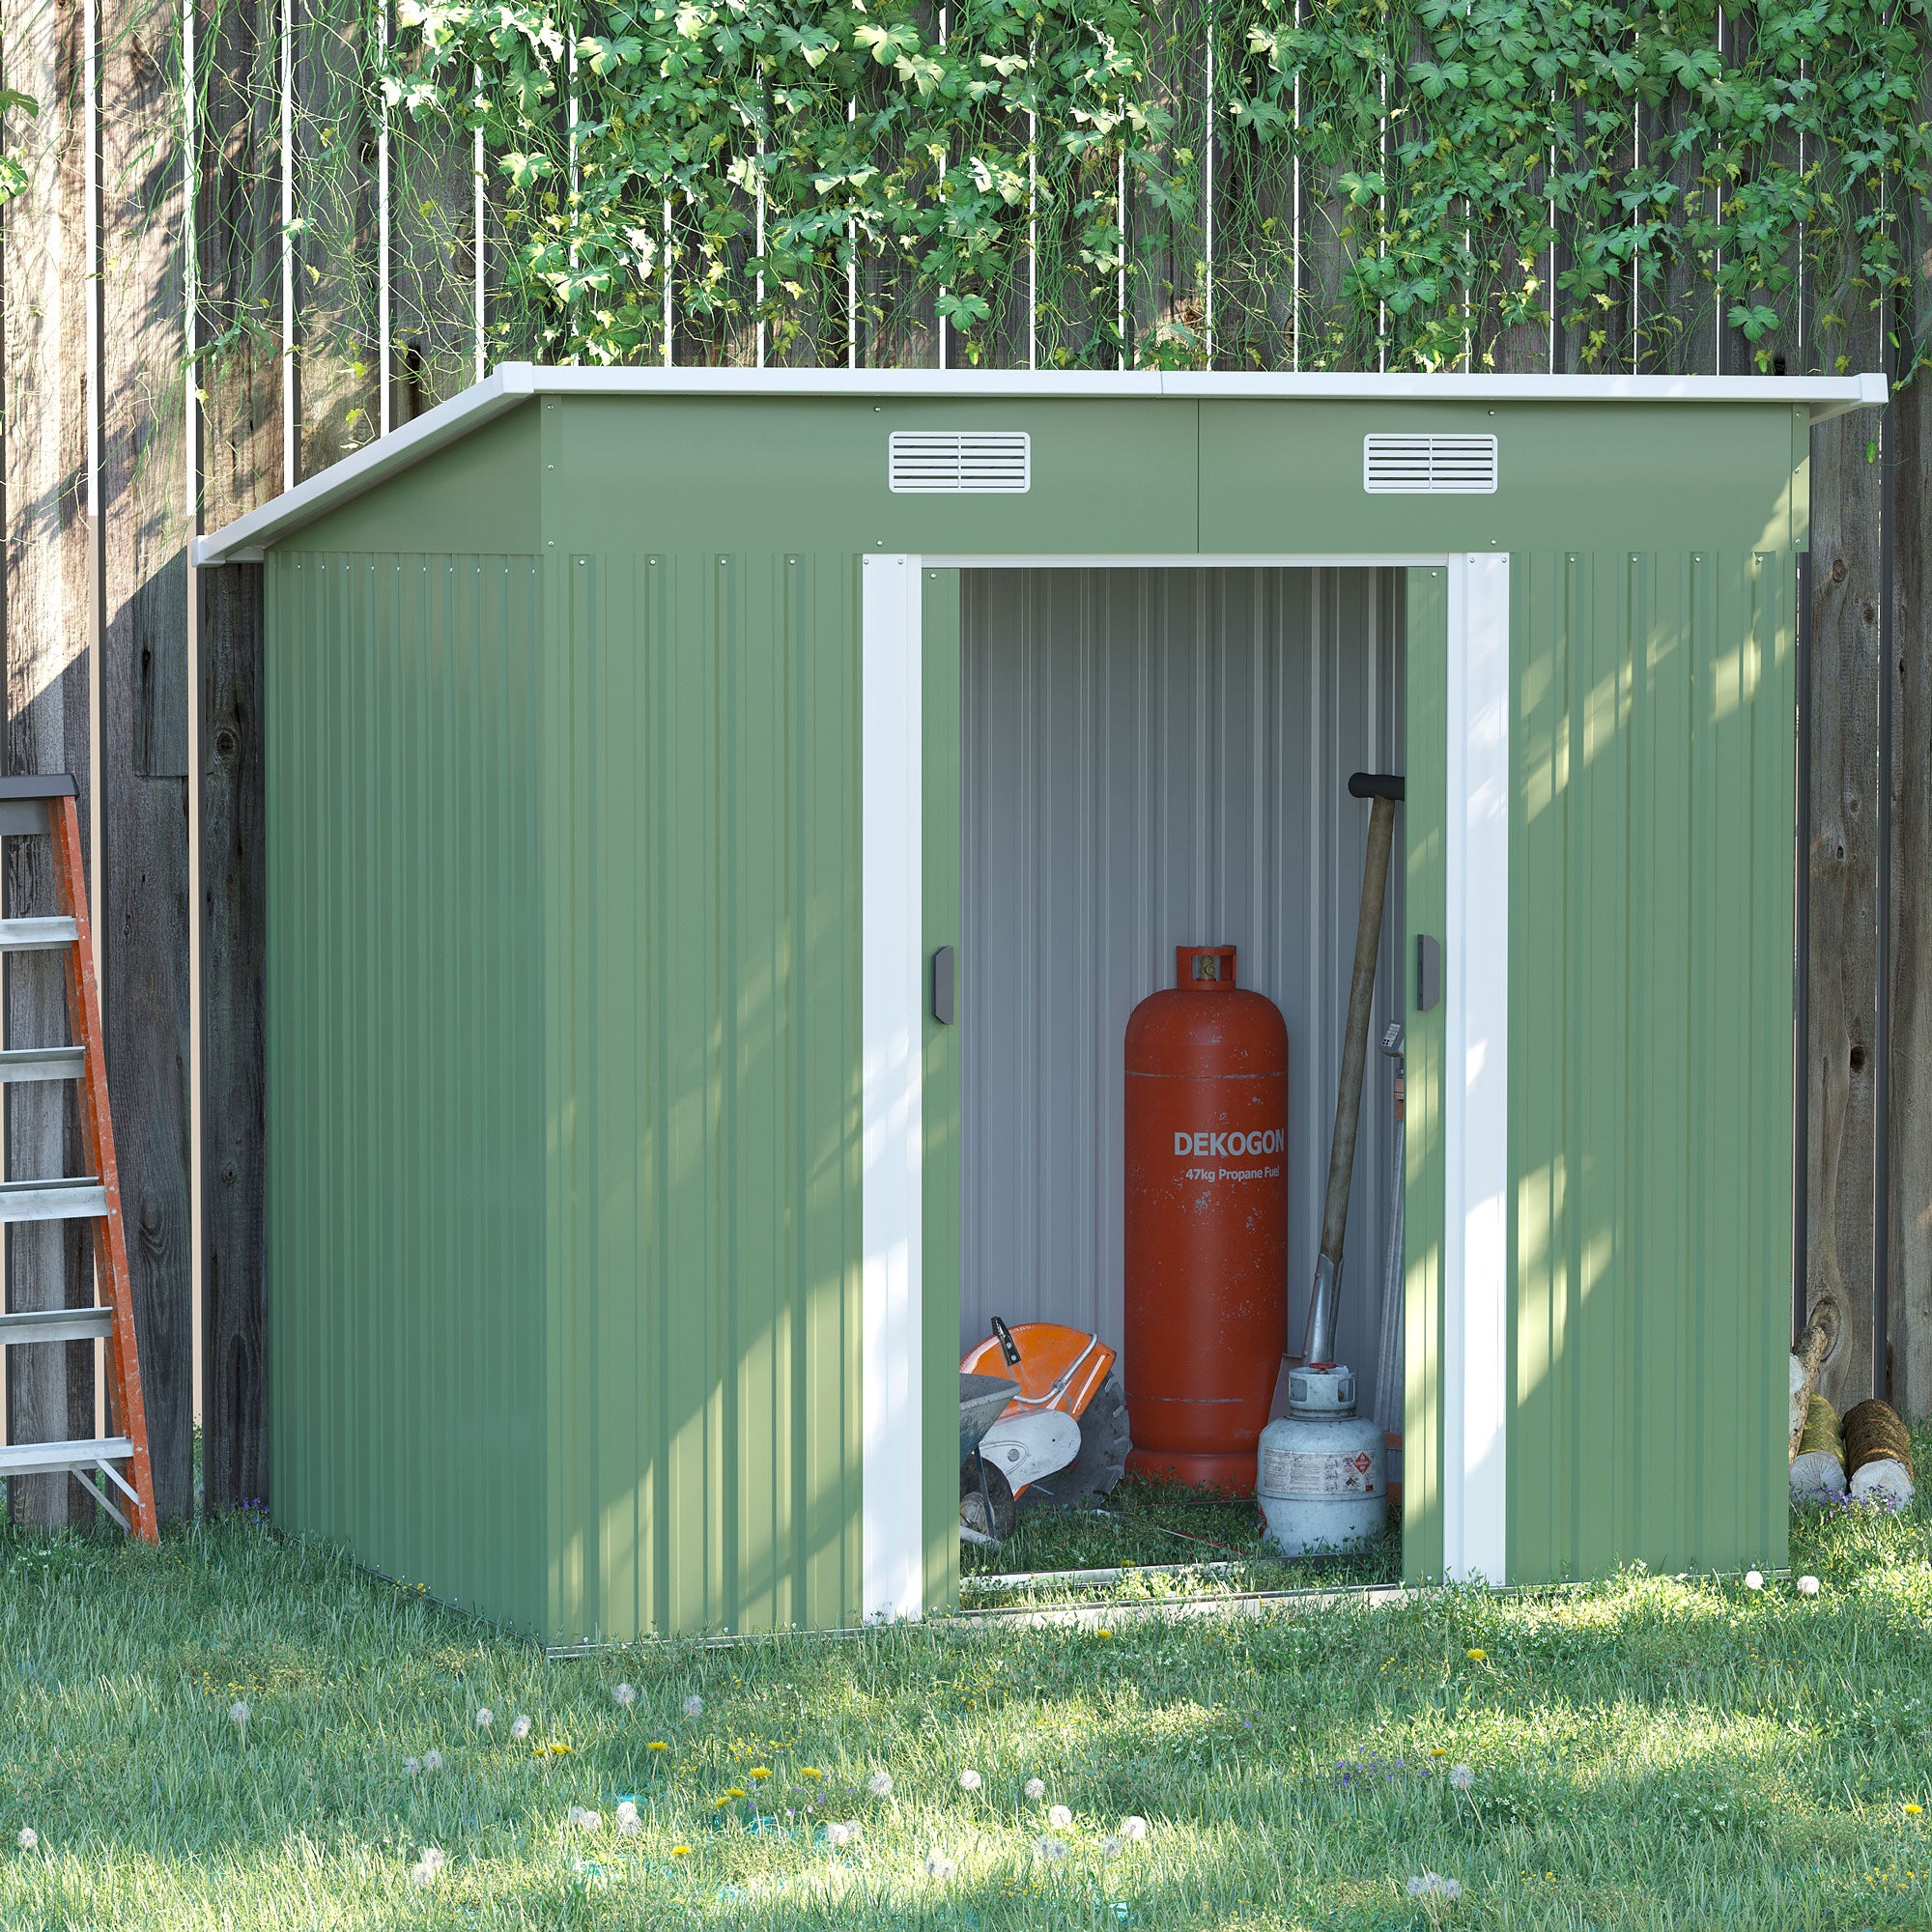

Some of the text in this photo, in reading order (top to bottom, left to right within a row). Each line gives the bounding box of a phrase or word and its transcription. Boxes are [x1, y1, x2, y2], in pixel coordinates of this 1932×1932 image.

[1174, 1128, 1284, 1156] DEKOGON
[1185, 1165, 1280, 1182] 47kg Propane Fuel
